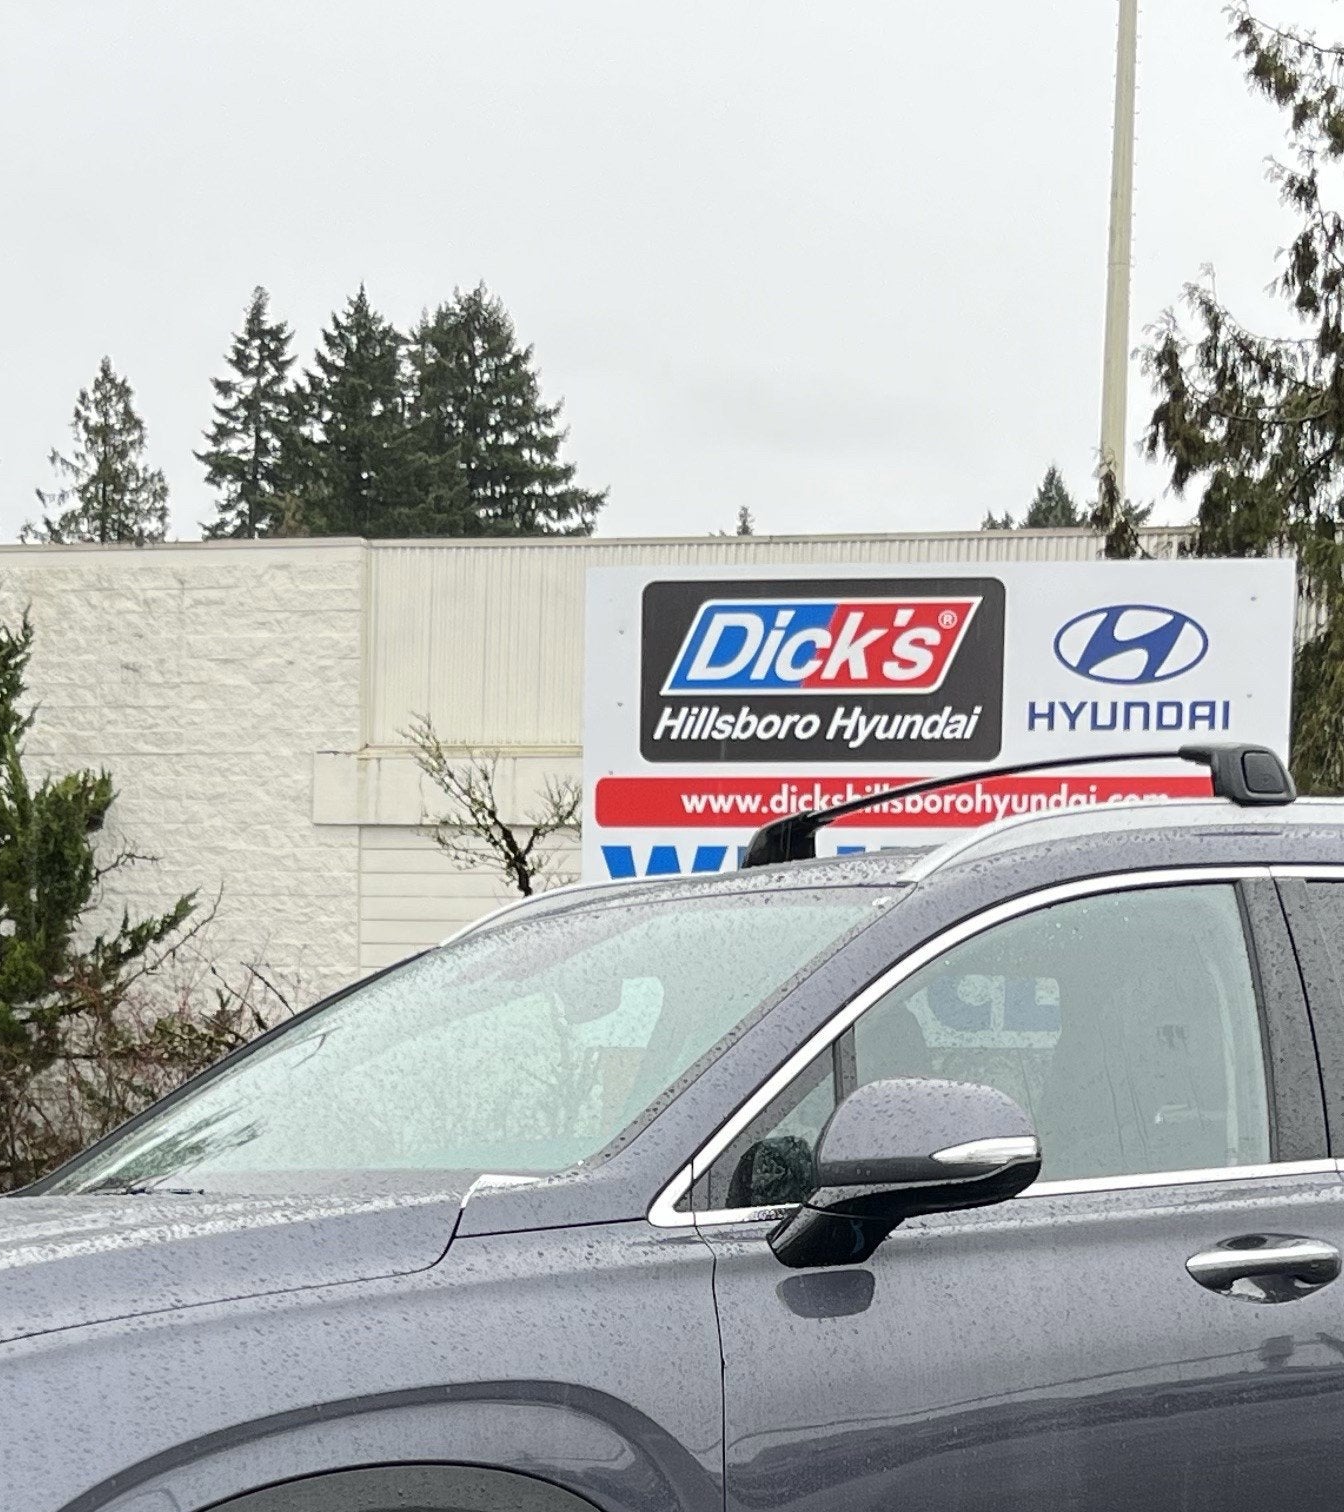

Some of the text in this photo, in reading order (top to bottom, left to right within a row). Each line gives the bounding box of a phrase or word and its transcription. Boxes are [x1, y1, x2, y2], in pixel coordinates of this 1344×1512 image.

[686, 608, 942, 681] Dick's
[653, 705, 983, 749] Hillsboro Hyundai
[1027, 700, 1231, 732] HYUNDAI
